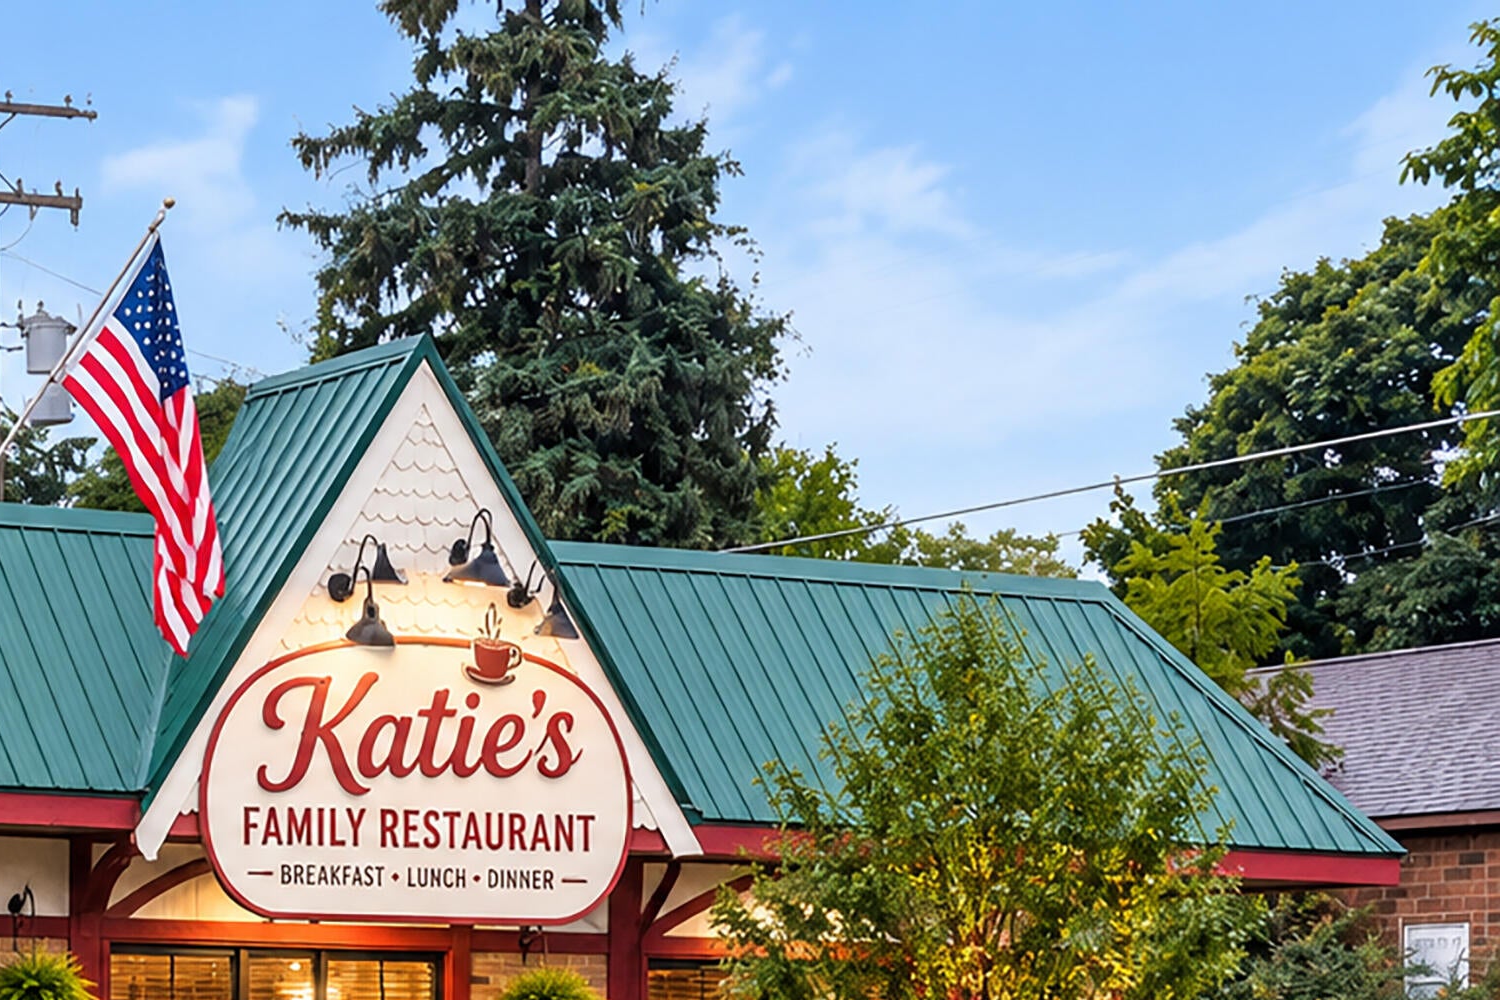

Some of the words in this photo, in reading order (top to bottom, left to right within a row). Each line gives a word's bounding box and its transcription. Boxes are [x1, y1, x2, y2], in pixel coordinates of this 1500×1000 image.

[257, 672, 583, 796] Katie's
[243, 806, 366, 848] FAMILY
[380, 808, 596, 852] RESTAURANT
[280, 864, 385, 887] BREAKFAST
[406, 868, 466, 889] LUNCH
[487, 869, 554, 890] DINNER
